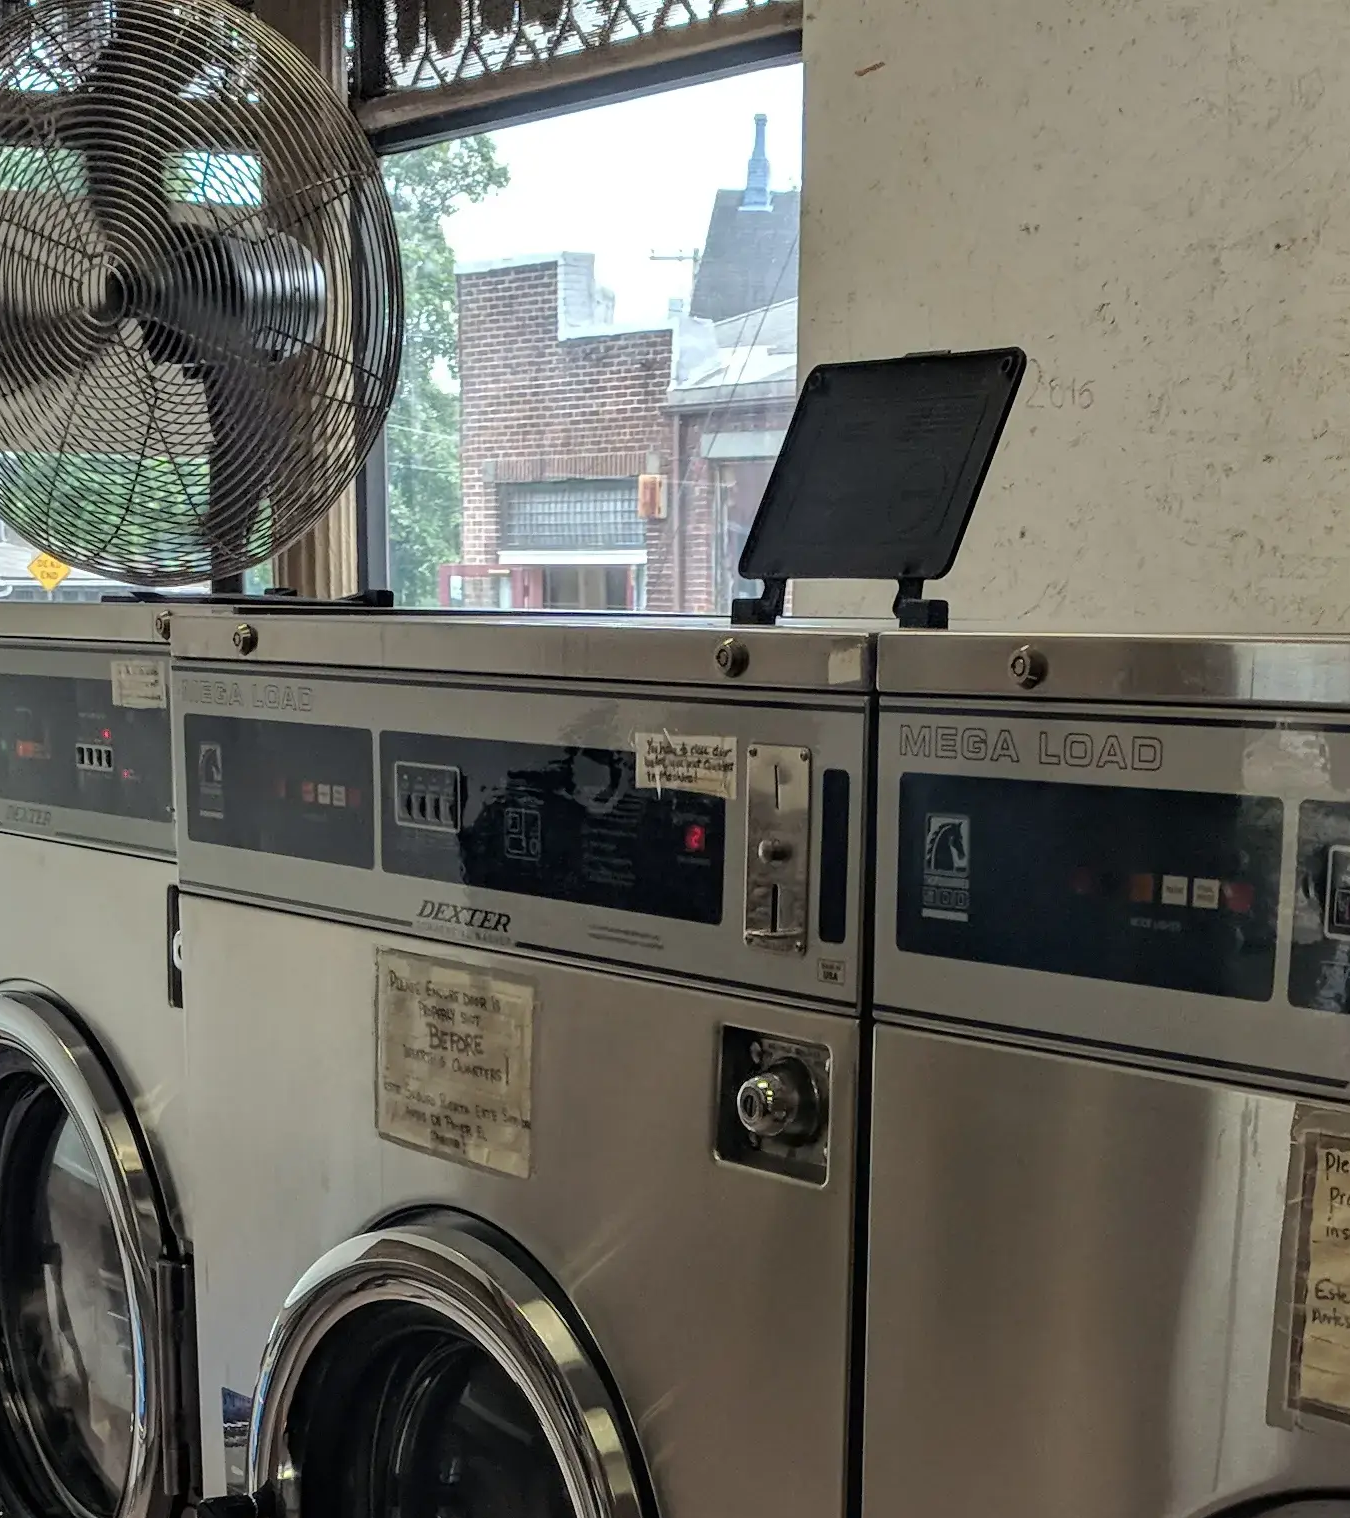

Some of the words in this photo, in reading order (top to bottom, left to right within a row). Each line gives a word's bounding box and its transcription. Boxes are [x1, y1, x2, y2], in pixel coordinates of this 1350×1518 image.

[40, 570, 58, 580] END
[252, 682, 313, 712] LOAD
[899, 723, 1020, 763] MEGA
[1038, 730, 1164, 772] LOAD
[417, 899, 512, 933] DEXTER
[823, 970, 838, 981] USA
[425, 1021, 485, 1057] BEFORE
